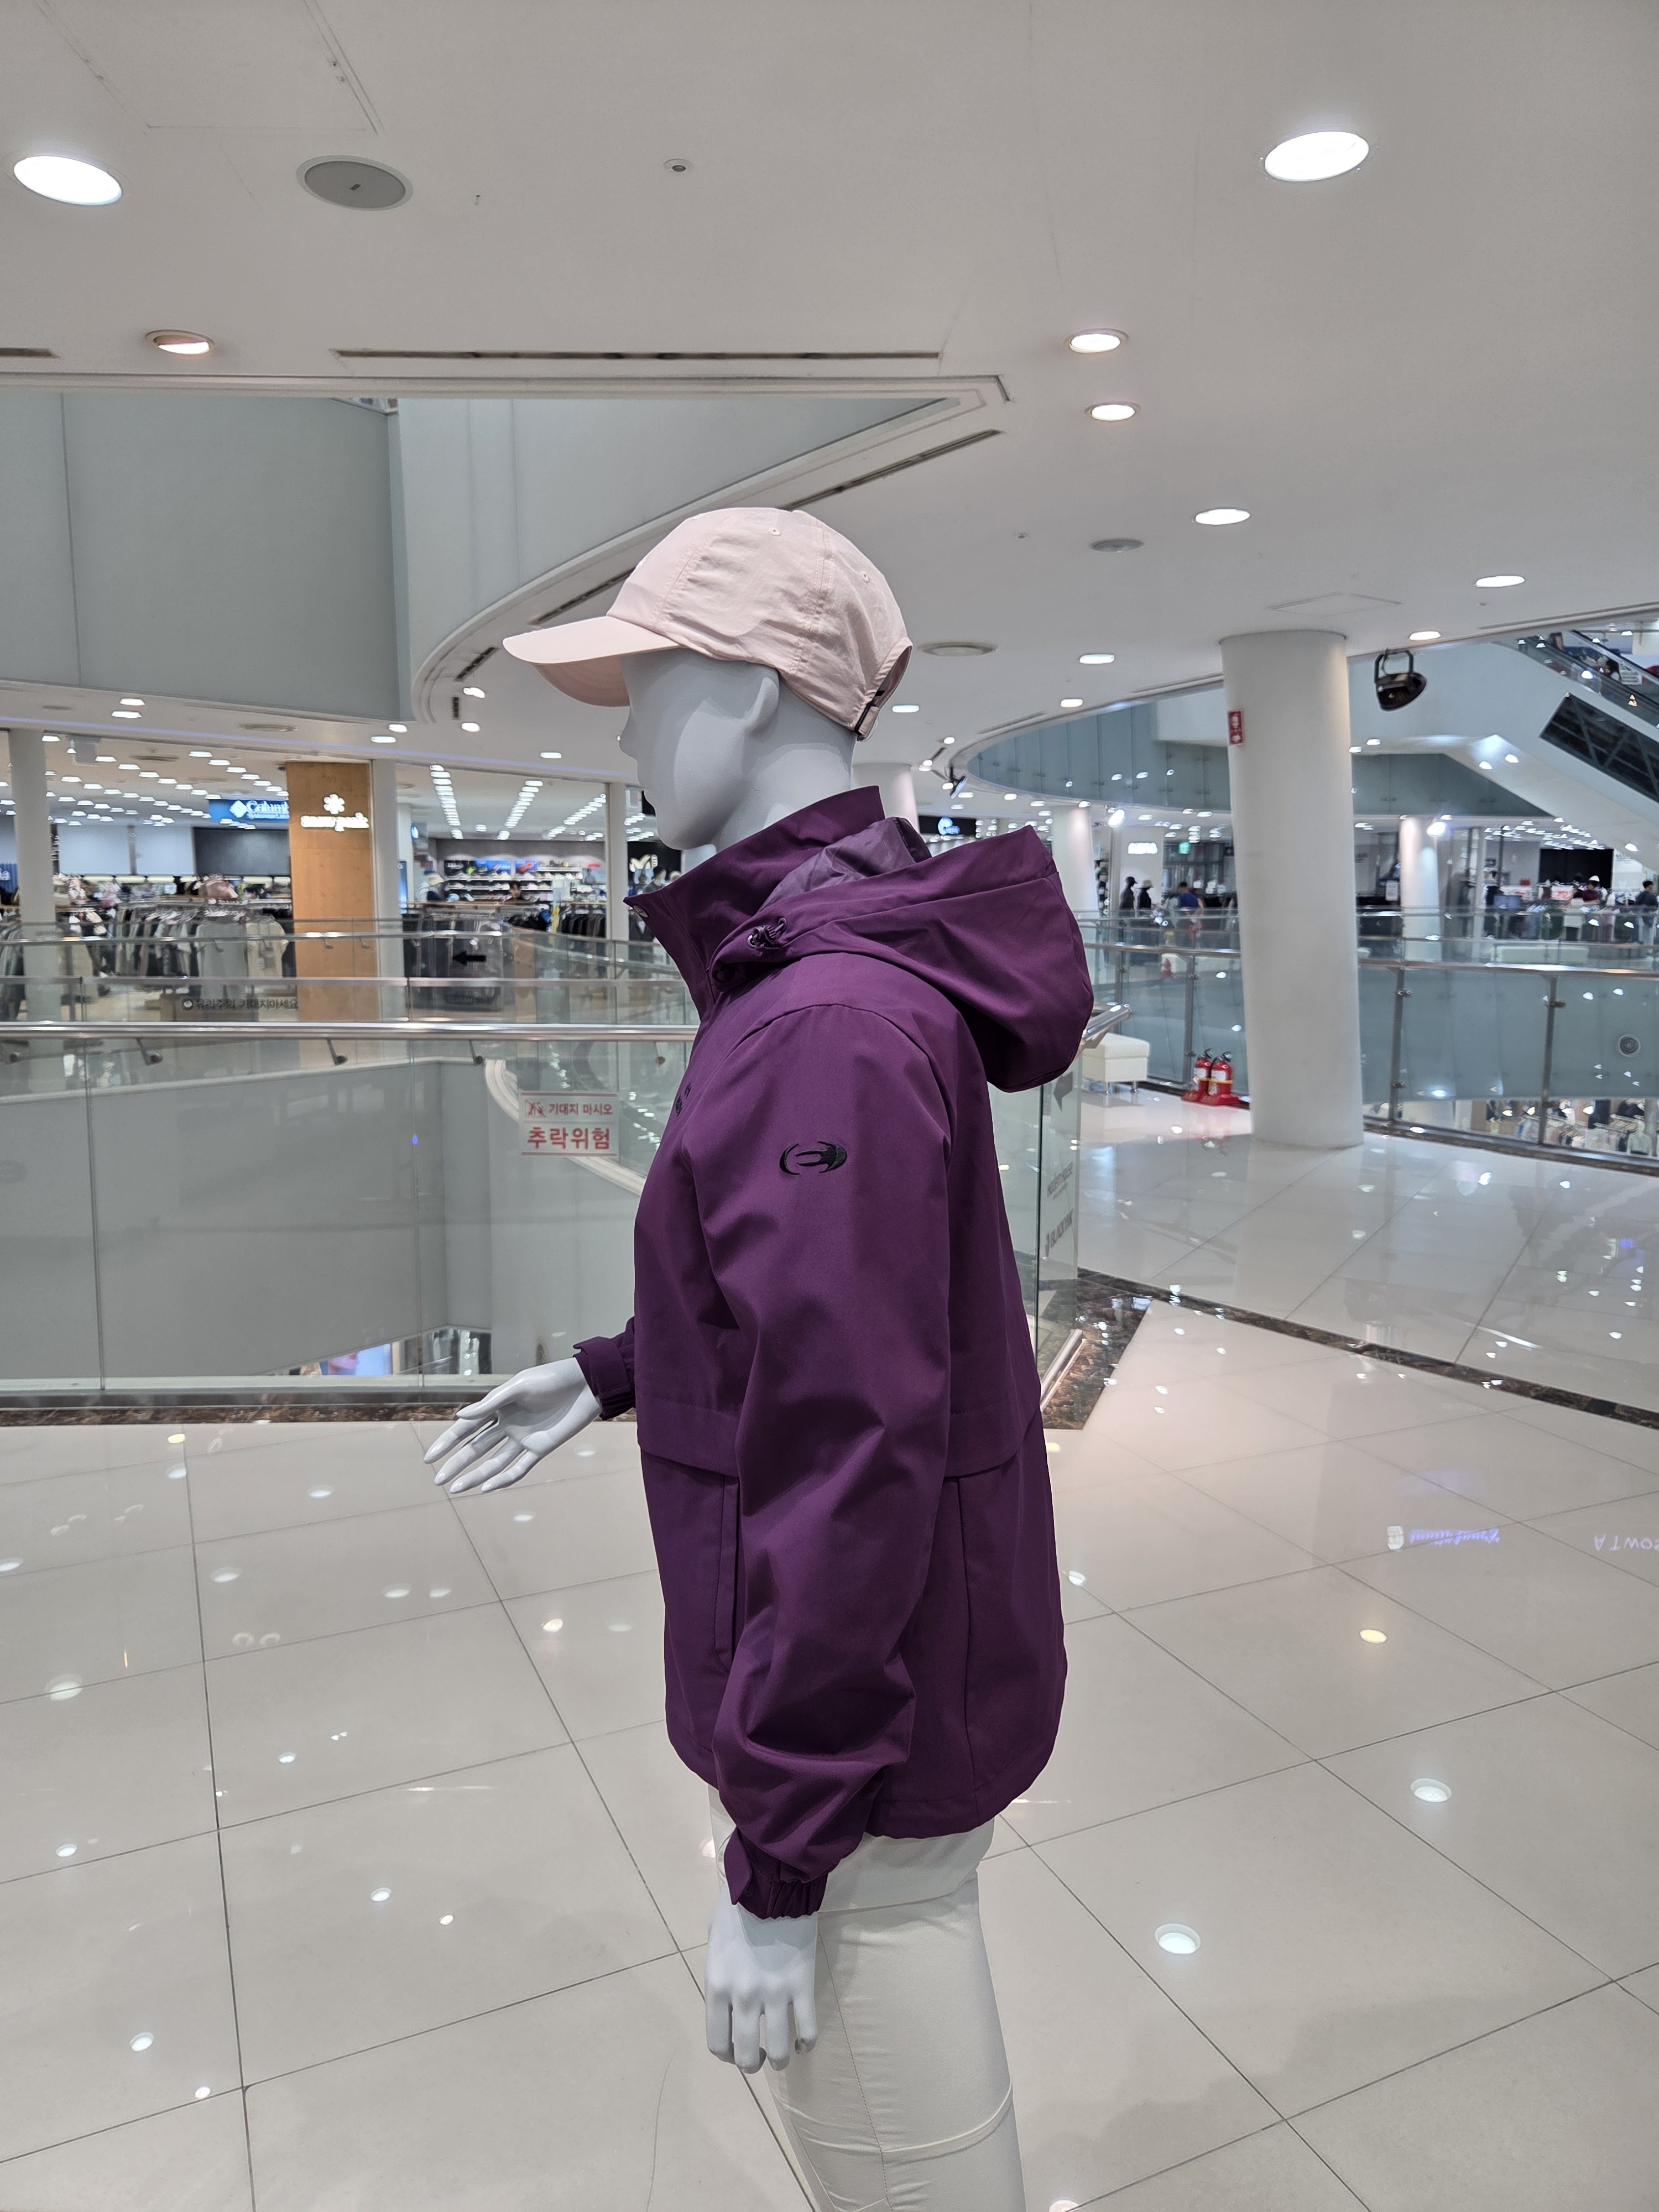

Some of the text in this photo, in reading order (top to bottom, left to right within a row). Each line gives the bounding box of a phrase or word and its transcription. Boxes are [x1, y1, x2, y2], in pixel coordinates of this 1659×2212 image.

[549, 1102, 613, 1116] 기대지 마시오
[528, 1126, 611, 1150] 추락위험
